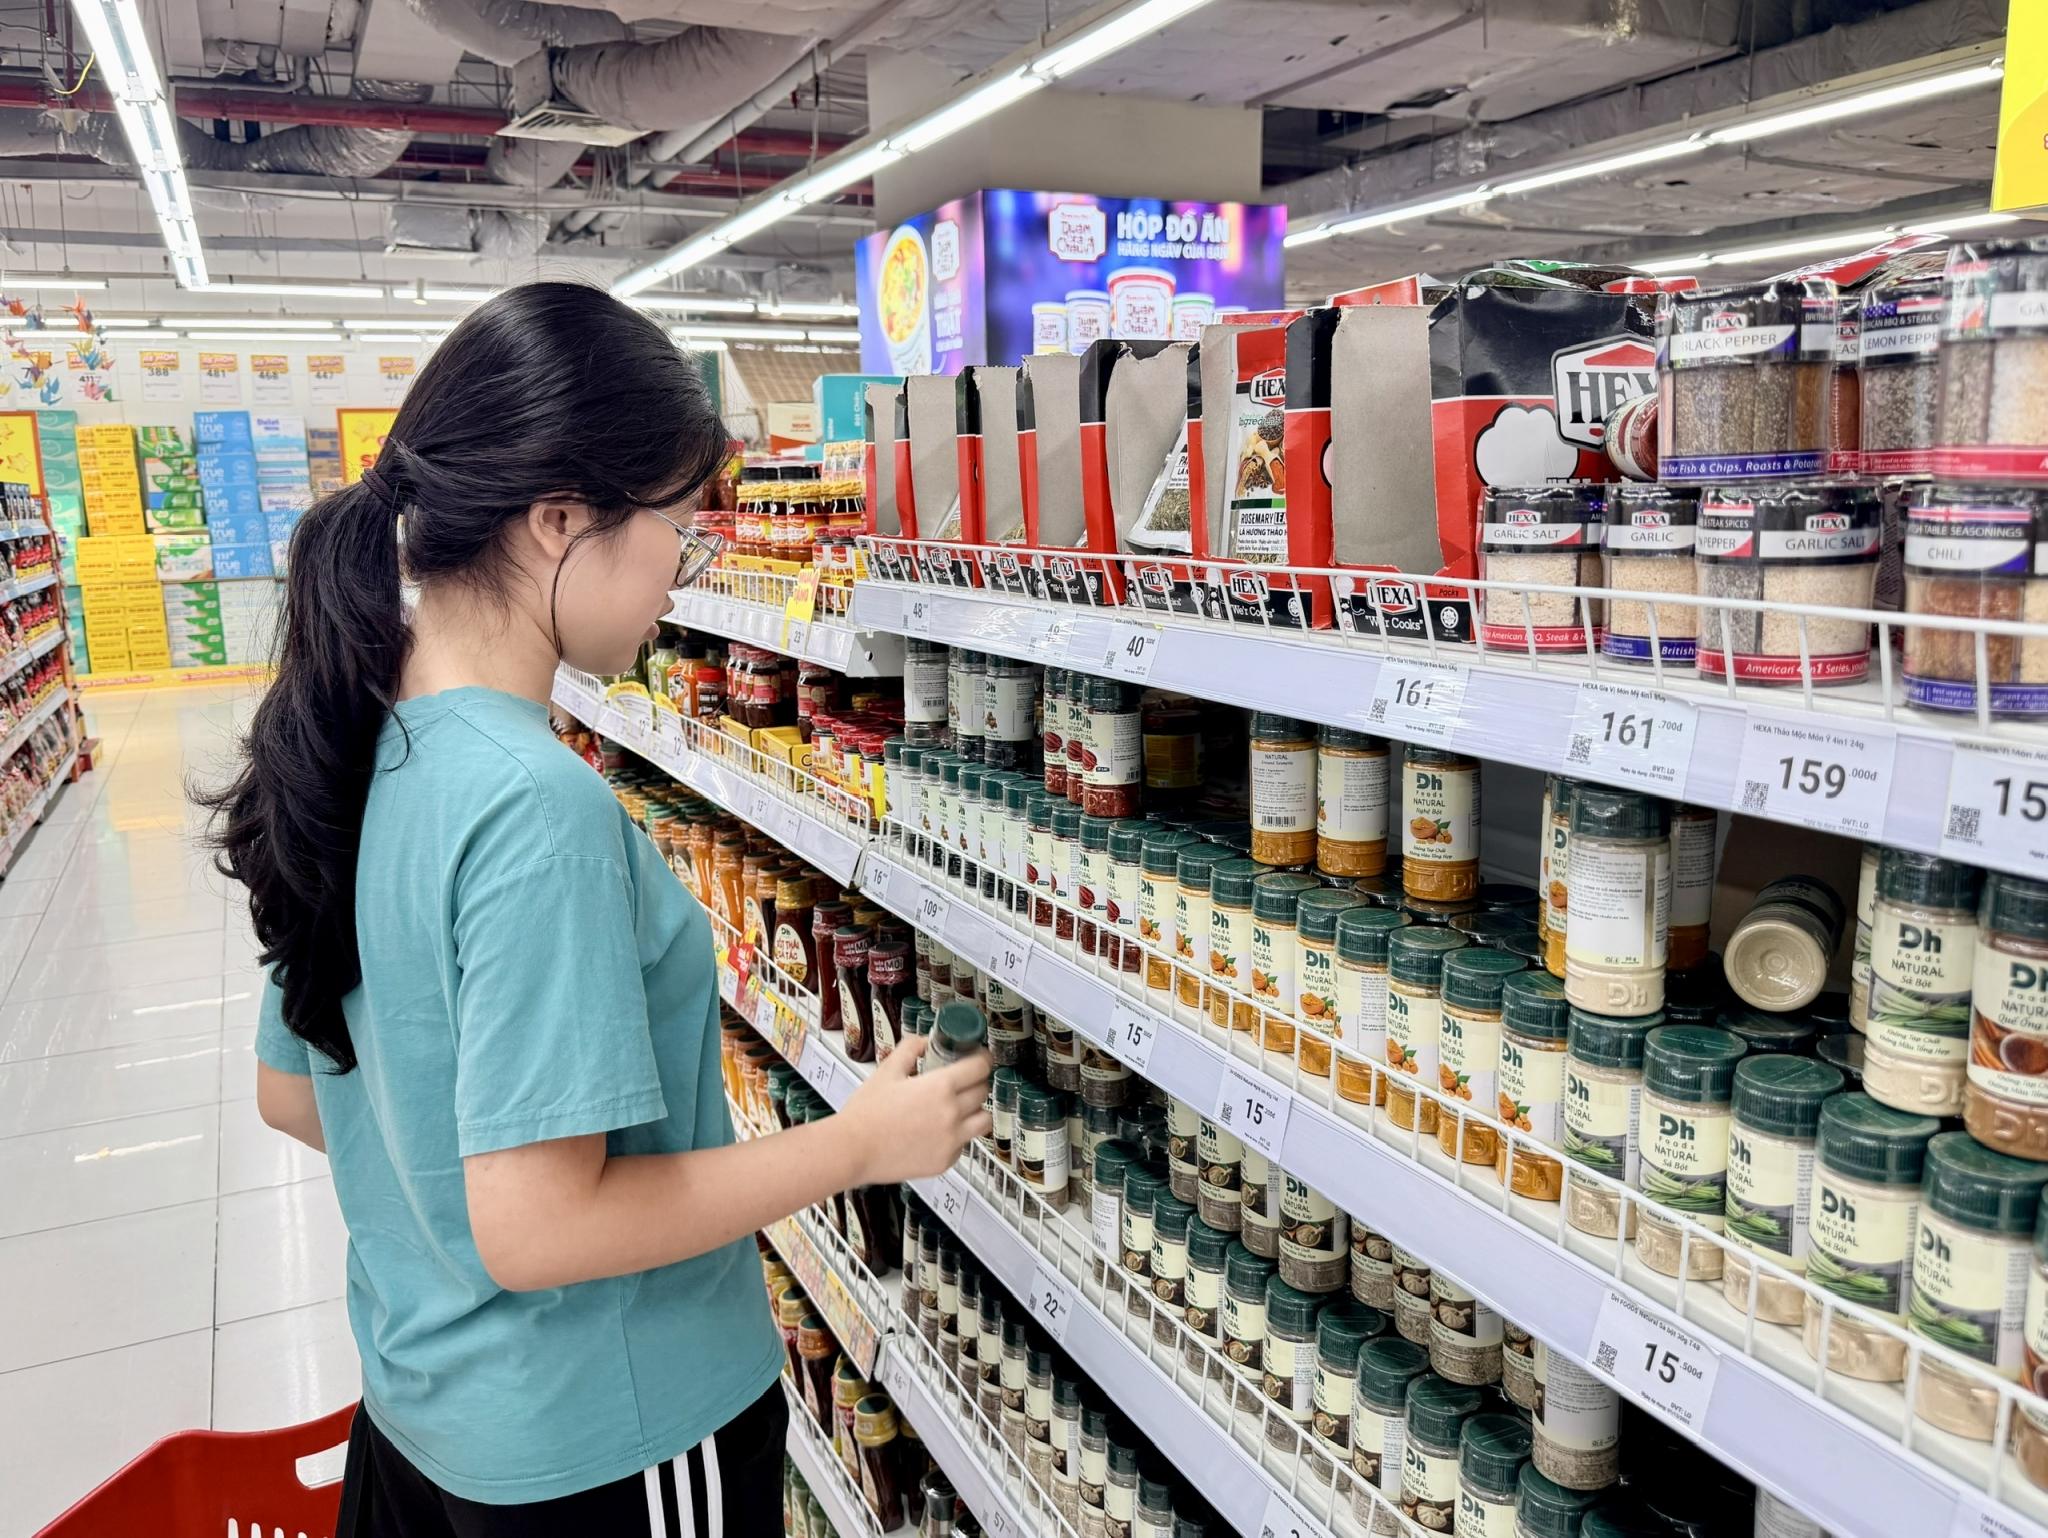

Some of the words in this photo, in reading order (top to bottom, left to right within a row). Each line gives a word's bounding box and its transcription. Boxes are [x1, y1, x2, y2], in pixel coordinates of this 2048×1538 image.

[1704, 316, 1745, 329] HEXA
[1682, 337, 1722, 352] BLACK
[1725, 333, 1777, 348] PEPPER
[1864, 335, 1896, 350] LEMON
[1680, 462, 1697, 474] Fish
[1699, 461, 1706, 473] &
[1745, 458, 1781, 472] Roasts
[1784, 457, 1790, 469] &
[1240, 512, 1273, 525] ROSEMARY
[1508, 513, 1538, 523] HEXA
[1634, 515, 1668, 524] HEXA
[1725, 518, 1749, 529] SPICES
[1810, 517, 1846, 530] HEXA
[1493, 529, 1529, 539] GARLIC
[1532, 529, 1560, 540] SALT
[1630, 531, 1674, 543] GARLIC
[1924, 525, 1947, 536] TABLE
[1950, 525, 2023, 538] SEASONINGS
[1703, 536, 1736, 549] PEPPER
[1785, 538, 1837, 550] GARLIC
[1840, 535, 1866, 549] SALT
[912, 603, 923, 619] 48
[1491, 630, 1523, 641] American
[1545, 632, 1569, 642] Steak
[1126, 635, 1144, 658] 40
[1660, 645, 1696, 657] British
[1745, 662, 1794, 675] American
[1582, 681, 1598, 691] HEXA
[1602, 711, 1654, 750] 161
[1753, 723, 1772, 735] HEXA
[1849, 739, 1865, 751] 24g
[1264, 753, 1289, 761] NATURAL
[1416, 772, 1443, 791] Dh
[1779, 756, 1846, 800] 159
[1413, 798, 1446, 808] NATURAL
[873, 868, 882, 886] 16
[1141, 879, 1154, 897] Dh
[923, 898, 937, 918] 109
[1212, 910, 1229, 929] Dh
[1253, 926, 1271, 947] Dh
[1898, 923, 1942, 954] Dh
[1003, 950, 1016, 969] 19
[1305, 949, 1330, 970] Dh
[1896, 949, 1942, 965] Foods
[1890, 959, 1945, 979] NATURAL
[988, 981, 1003, 995] Dh
[1302, 973, 1333, 986] NATURAL
[1915, 976, 1933, 990] Bột
[1388, 991, 1409, 1016] Dh
[1127, 1022, 1143, 1046] 15
[1442, 1014, 1463, 1039] Dh
[1502, 1040, 1523, 1069] Dh
[815, 1063, 824, 1077] 31
[1567, 1073, 1589, 1103] Dh
[1246, 1098, 1264, 1126] 15
[1200, 1121, 1217, 1139] Dh
[1659, 1113, 1695, 1141] Dh
[1658, 1136, 1695, 1150] Foods
[1729, 1134, 1752, 1165] Dh
[1654, 1144, 1699, 1163] NATURAL
[1286, 1175, 1308, 1198] Dh
[943, 1192, 956, 1215] 32
[1284, 1199, 1311, 1213] NATURAL
[1821, 1186, 1856, 1223] Dh
[1816, 1220, 1859, 1248] NATURAL
[1920, 1223, 1952, 1262] Dh
[1043, 1292, 1059, 1319] 22
[1644, 1341, 1680, 1384] 15
[1406, 1447, 1427, 1473] Dh
[1462, 1490, 1486, 1521] Dh
